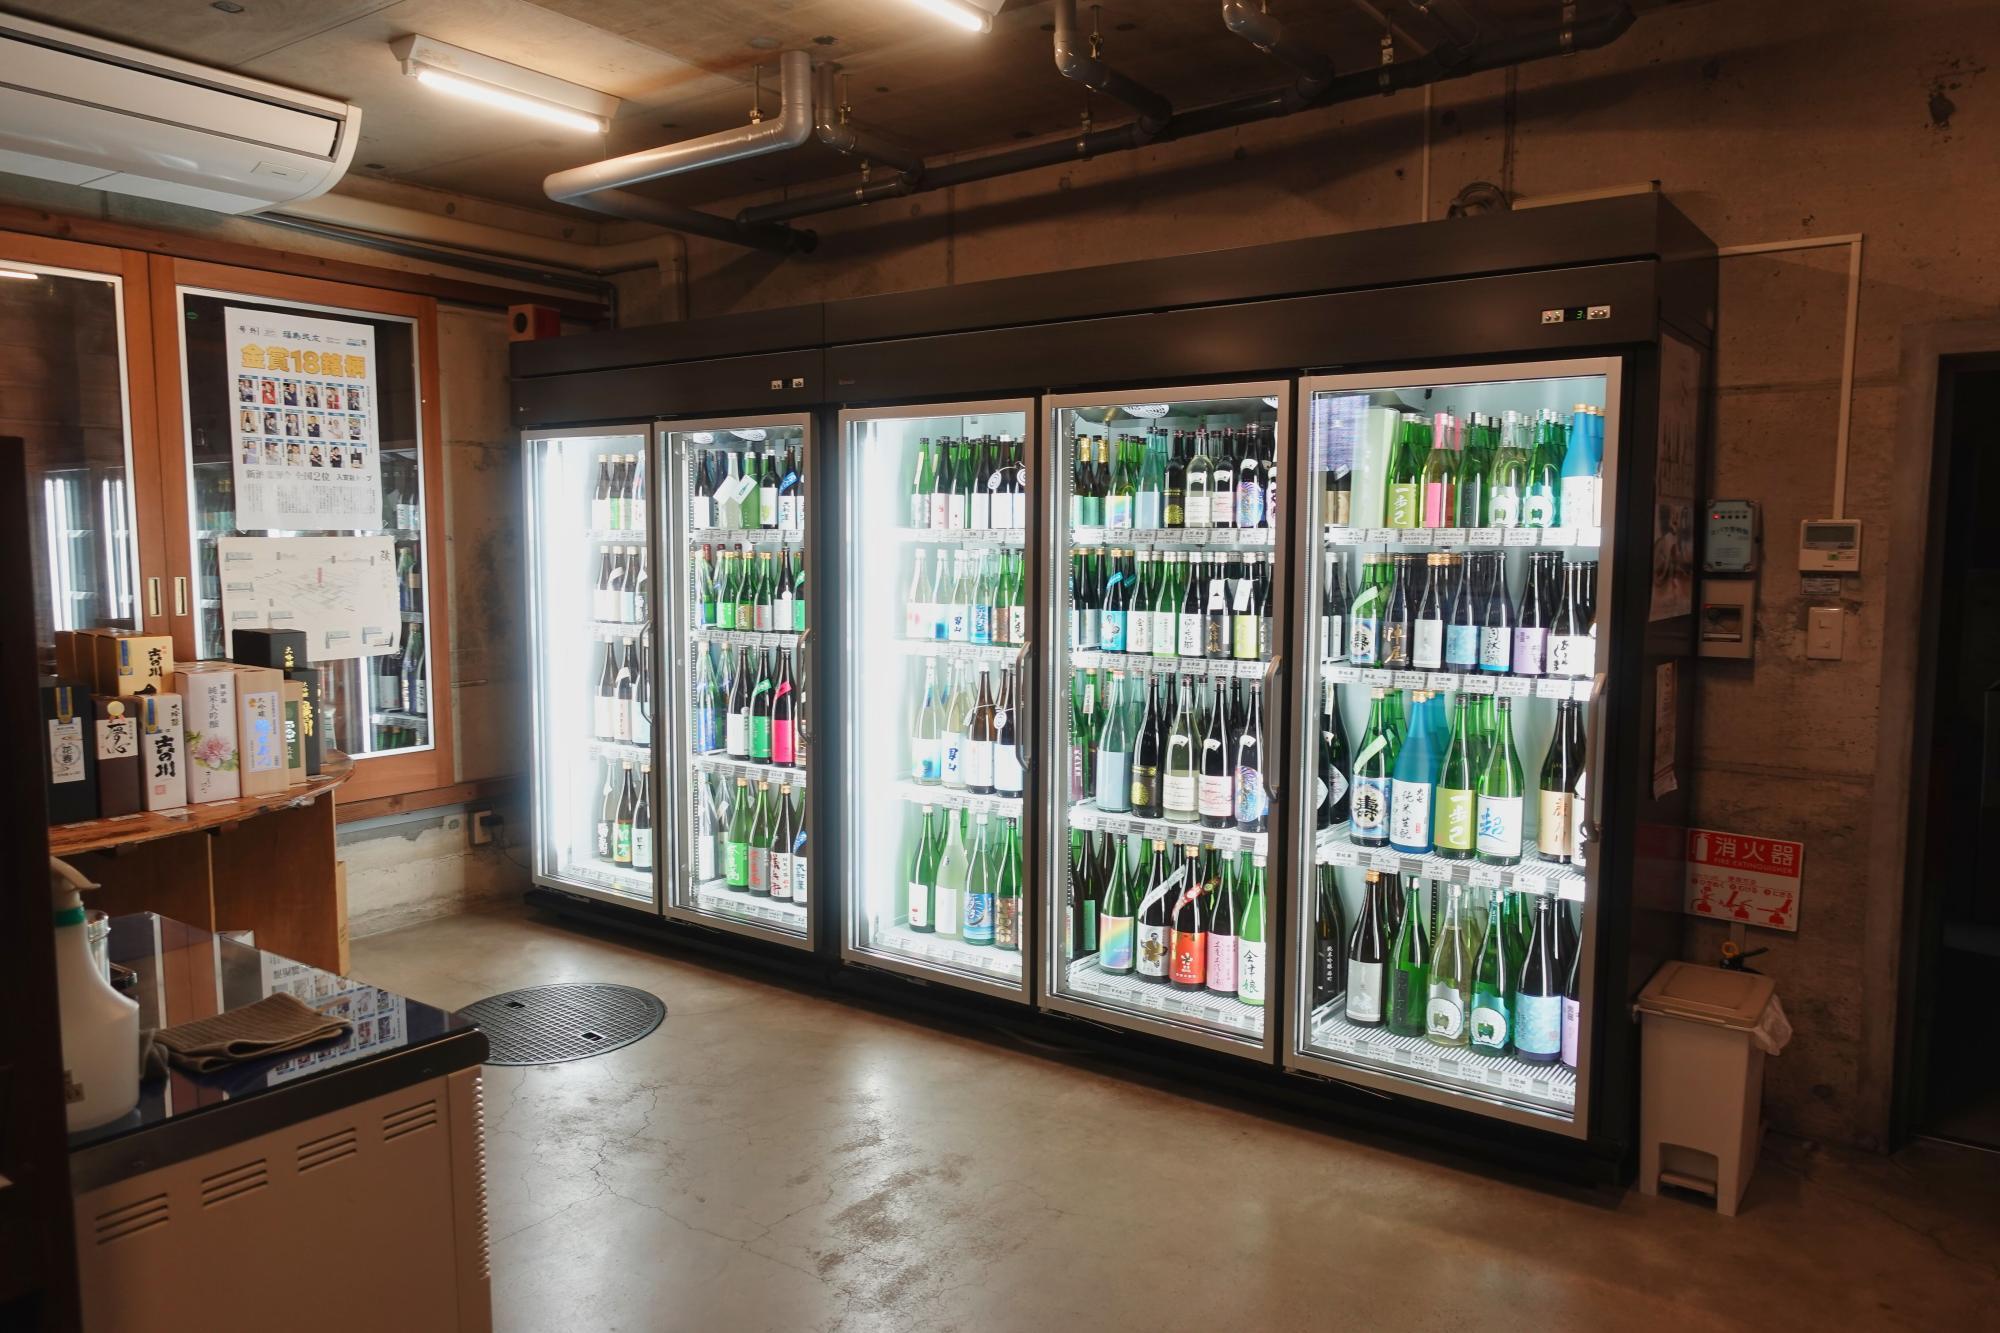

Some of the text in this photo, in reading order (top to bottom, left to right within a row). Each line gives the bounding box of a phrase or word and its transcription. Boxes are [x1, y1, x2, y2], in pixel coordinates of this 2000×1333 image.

[240, 343, 366, 379] 金賞18銘柄
[154, 735, 177, 777] 吉の川
[1714, 836, 1795, 867] 消火器
